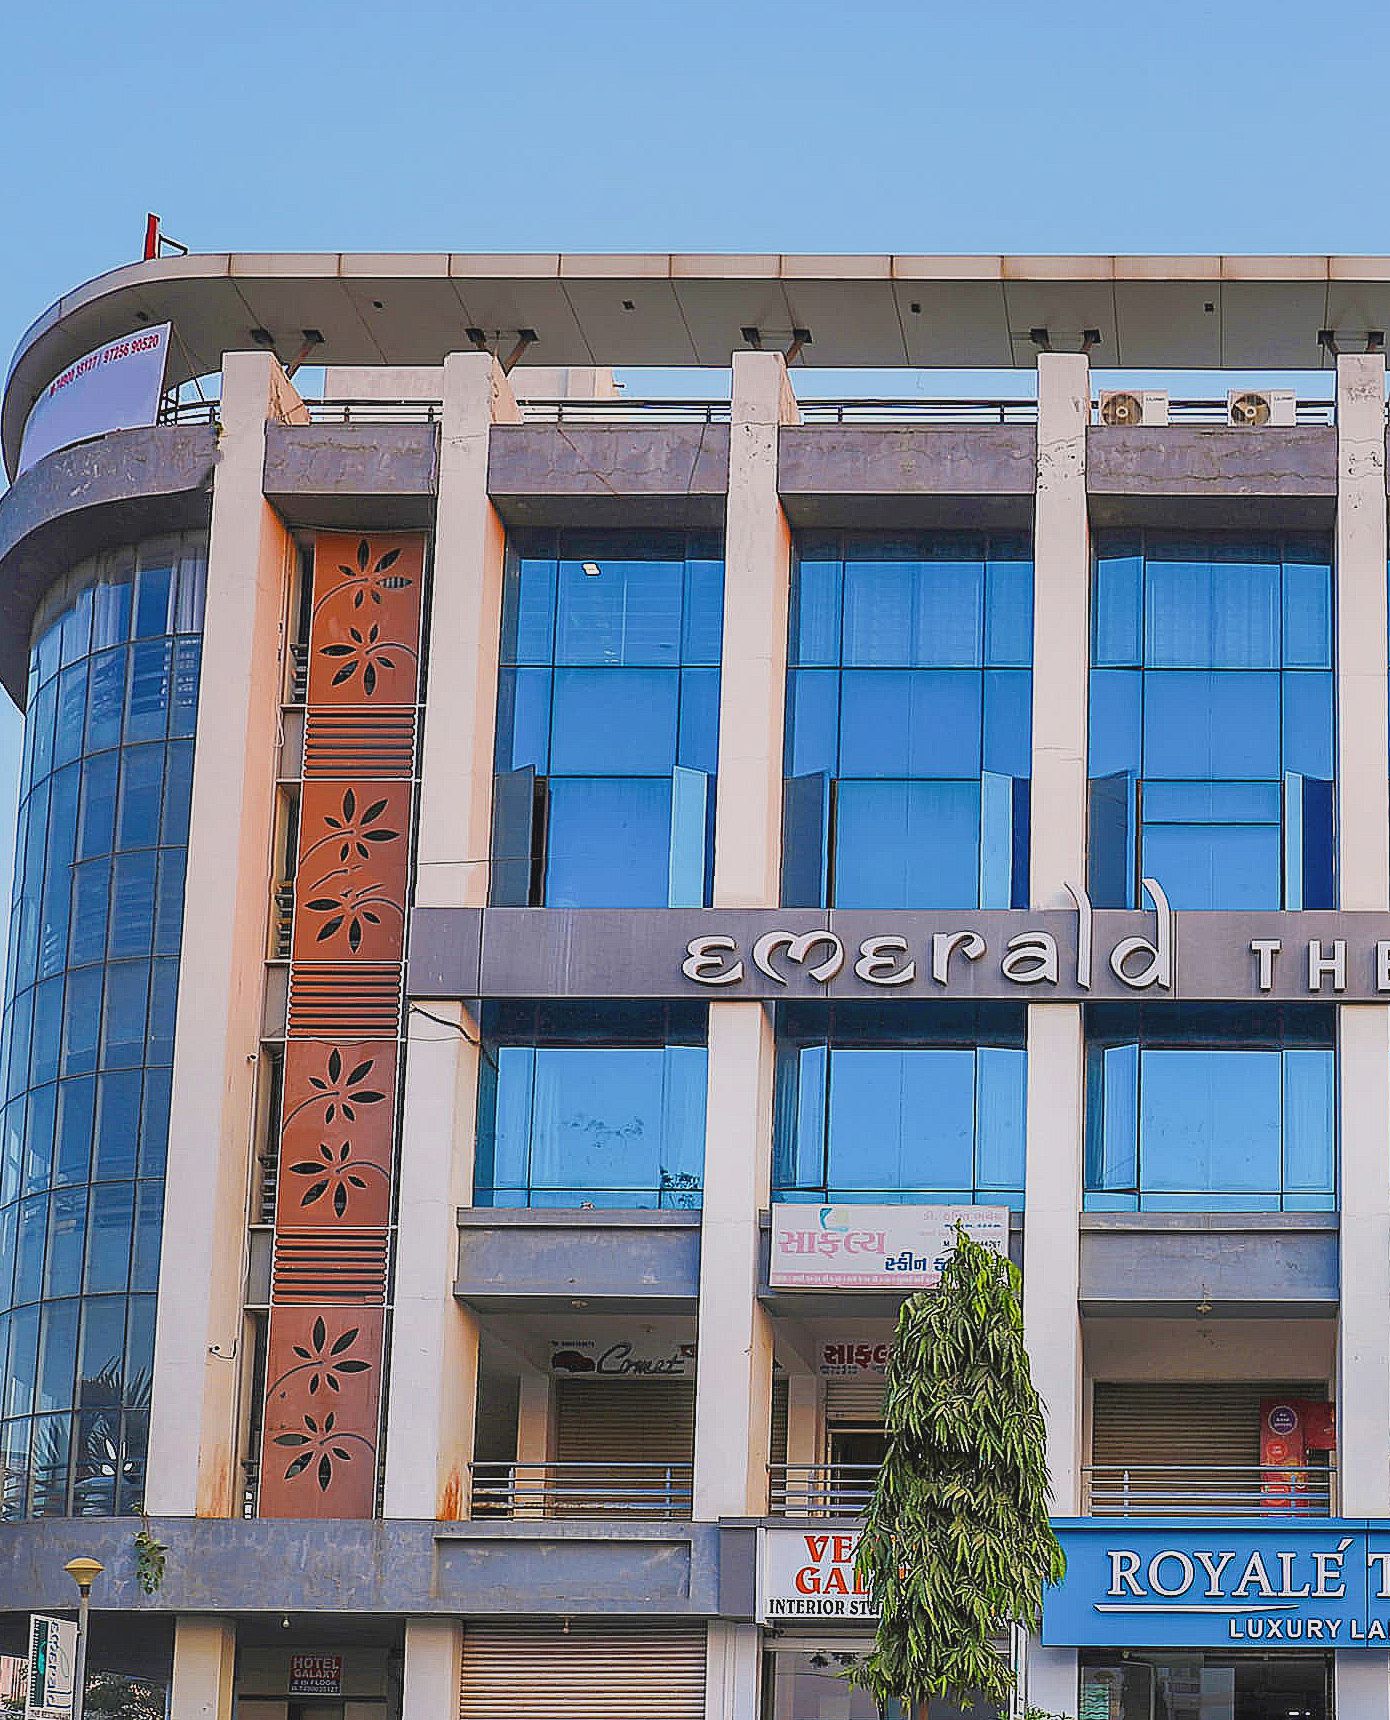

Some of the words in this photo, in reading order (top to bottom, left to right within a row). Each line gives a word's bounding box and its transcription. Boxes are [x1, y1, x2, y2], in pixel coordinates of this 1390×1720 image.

[682, 877, 1173, 990] emerald
[1106, 1538, 1356, 1600] ROYALÉ
[769, 1599, 846, 1615] INTERIOR
[1228, 1618, 1342, 1640] LUXURY
[293, 1657, 339, 1669] HOTEL
[294, 1668, 338, 1678] GALAXY
